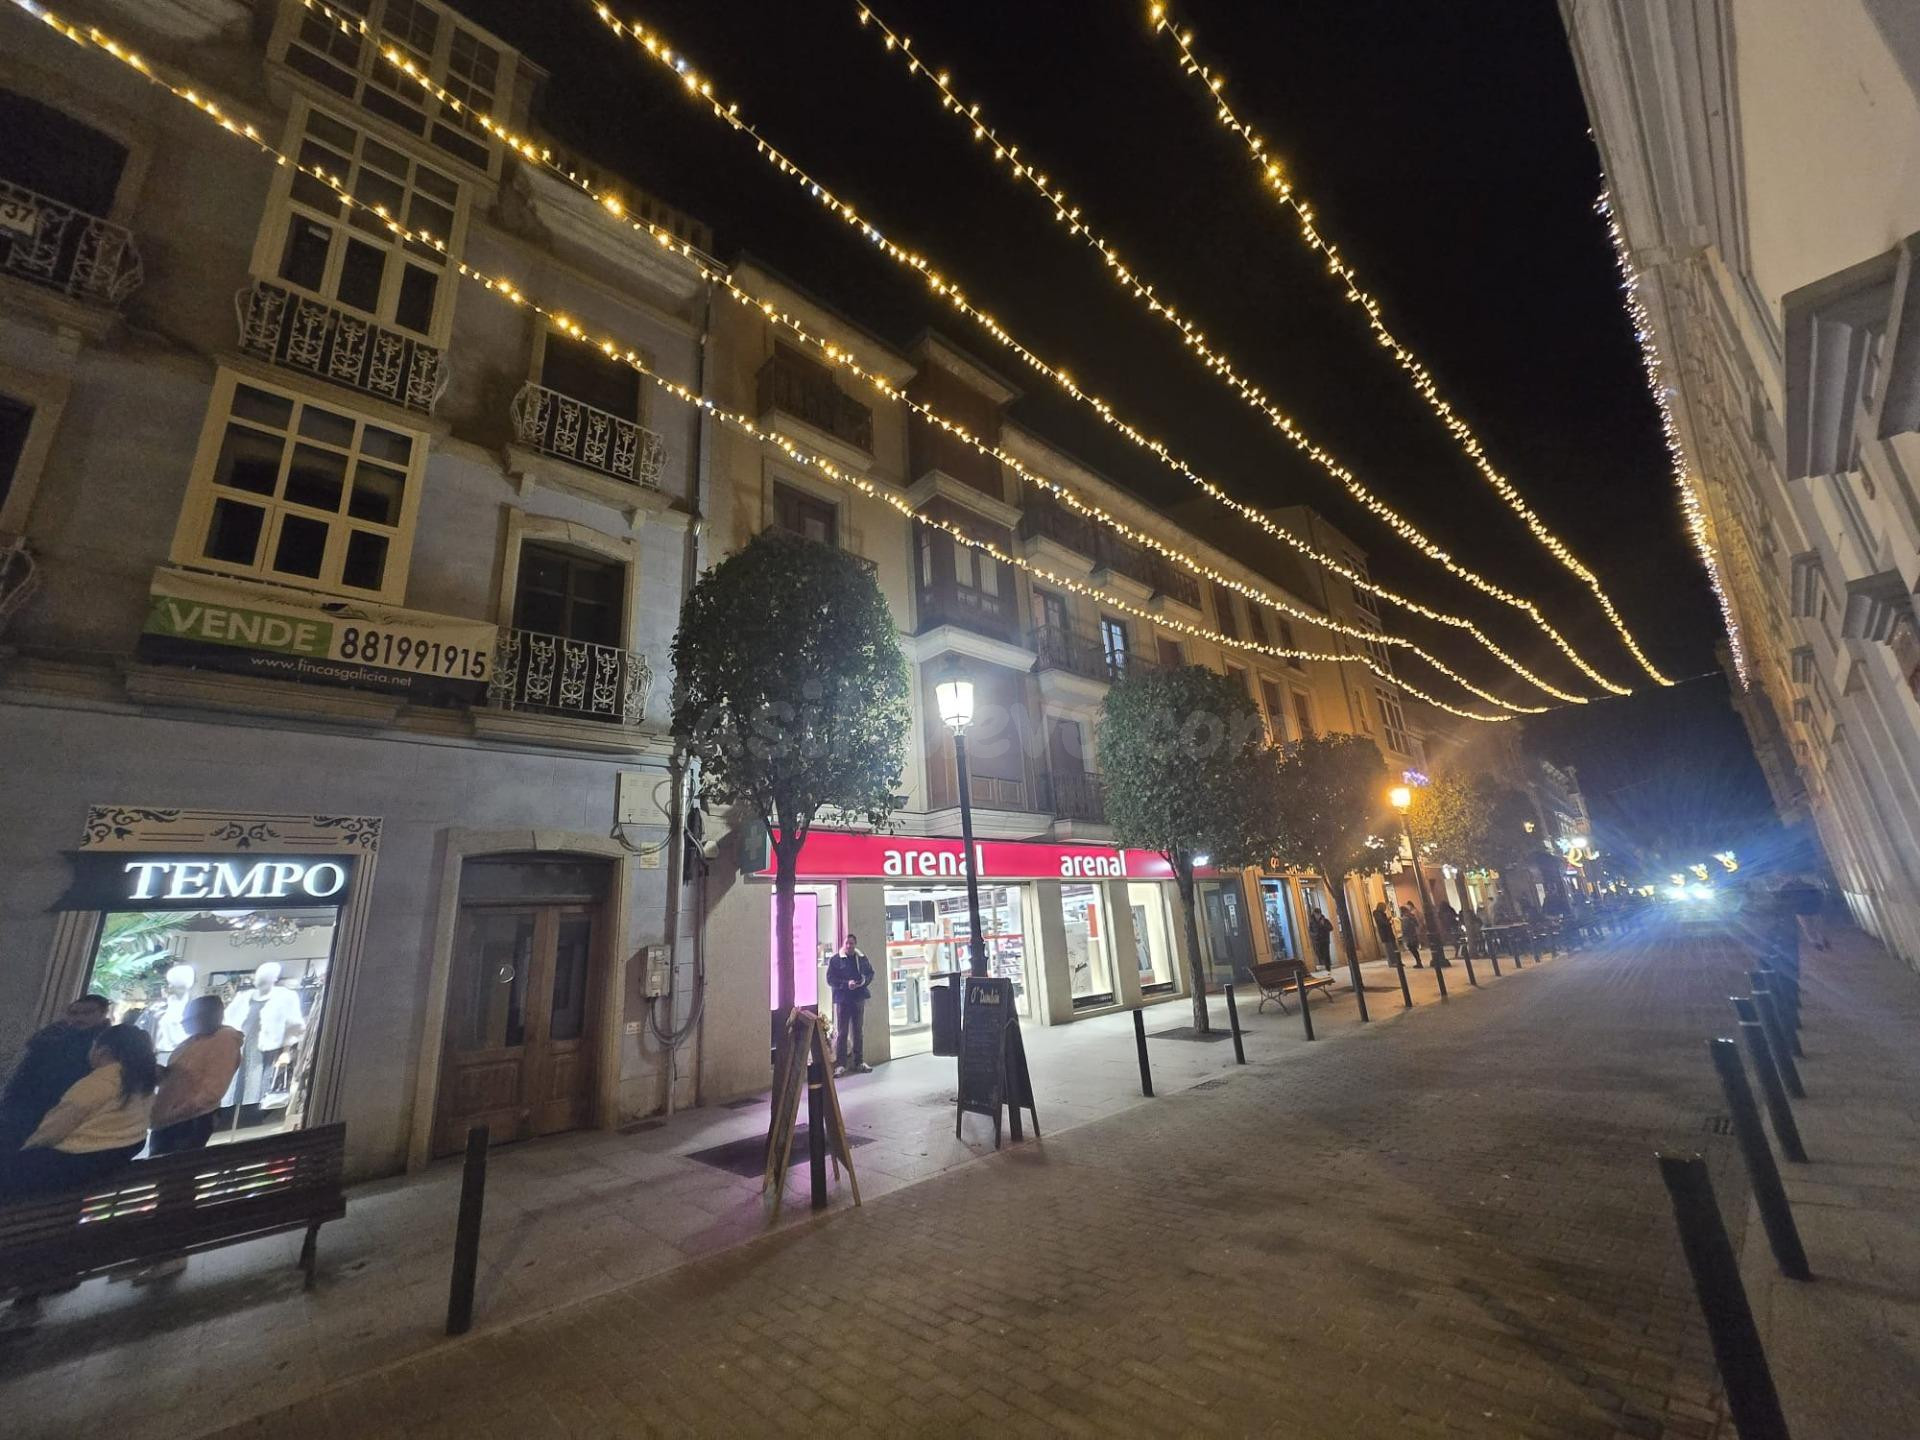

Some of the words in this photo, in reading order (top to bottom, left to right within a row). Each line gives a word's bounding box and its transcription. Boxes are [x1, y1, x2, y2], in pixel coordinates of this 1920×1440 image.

[168, 603, 318, 651] VENDE
[340, 627, 487, 678] 881991915
[250, 656, 413, 688] www.fincasgalicia.net
[125, 862, 345, 900] TEMPO
[1060, 850, 1127, 878] arenal
